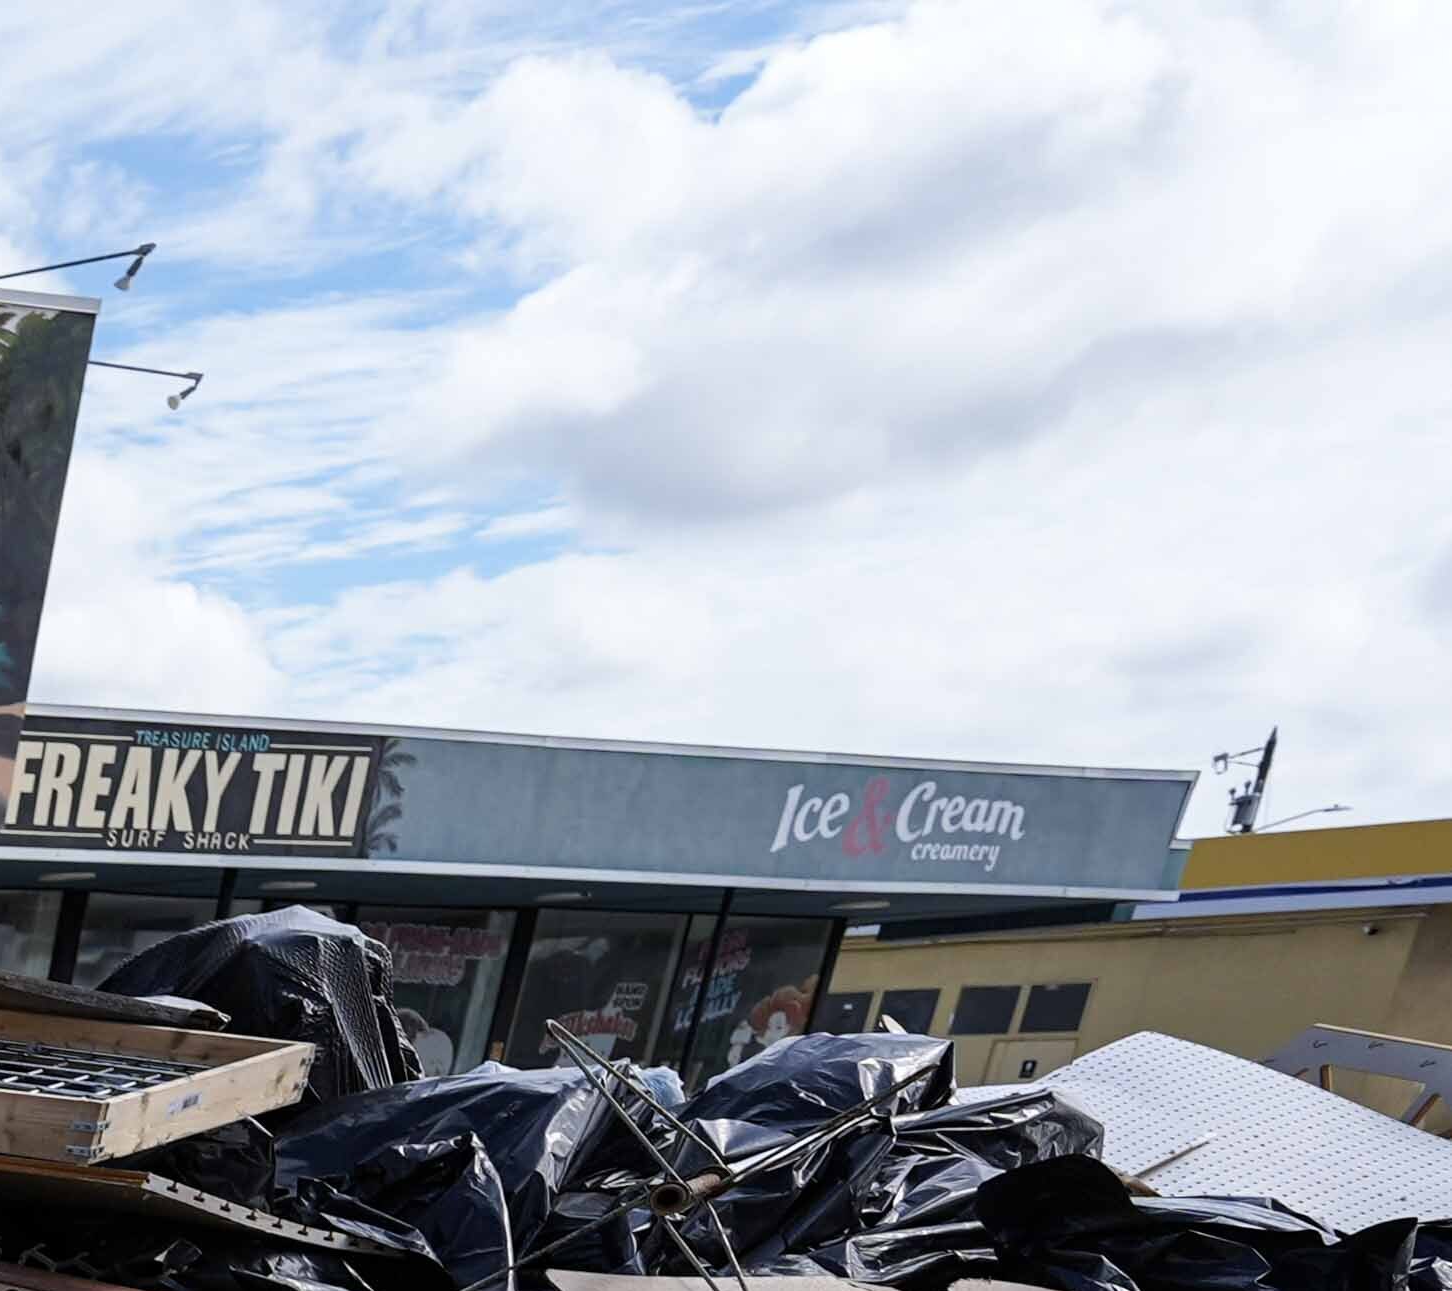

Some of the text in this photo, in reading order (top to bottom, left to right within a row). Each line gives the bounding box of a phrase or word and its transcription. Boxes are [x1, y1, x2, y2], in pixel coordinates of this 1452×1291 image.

[135, 729, 271, 752] TREASURE ISLAND
[4, 739, 372, 838] FREAKY TIKI
[770, 775, 1025, 858] Ice & Cream
[105, 829, 251, 851] SURF SHACK
[911, 843, 1000, 872] creamery
